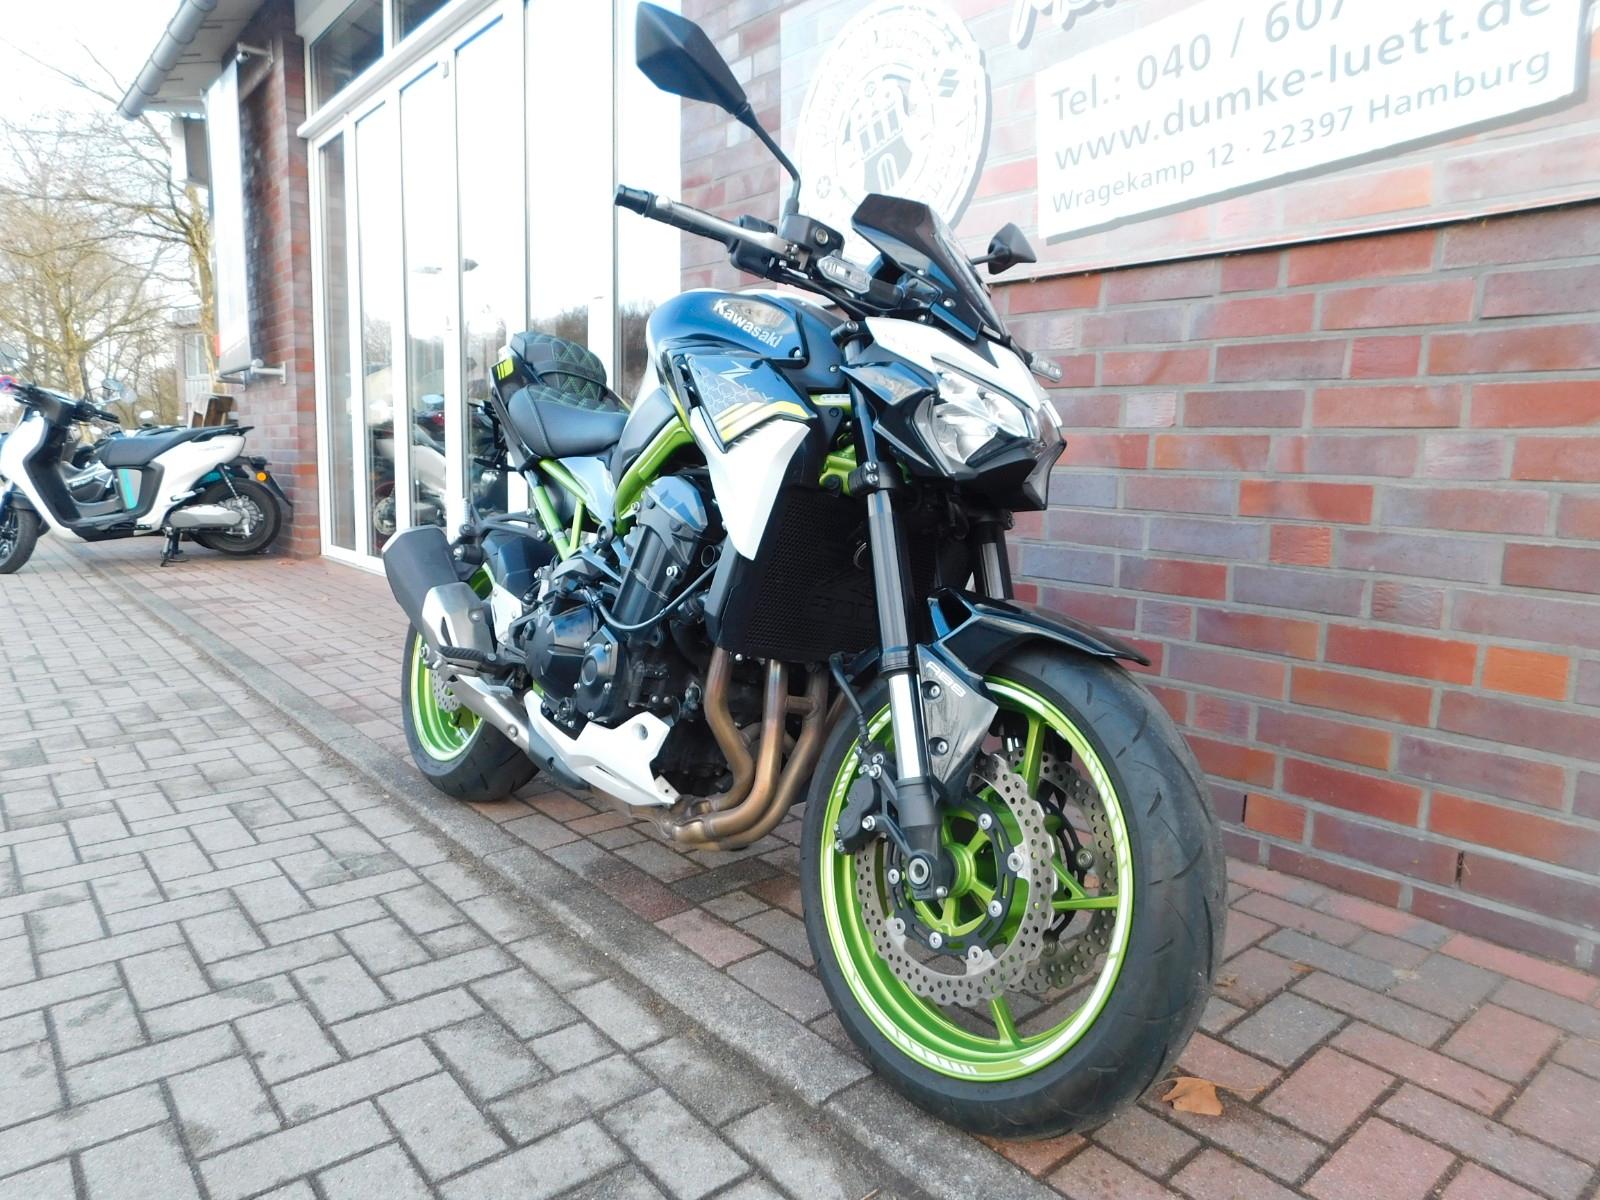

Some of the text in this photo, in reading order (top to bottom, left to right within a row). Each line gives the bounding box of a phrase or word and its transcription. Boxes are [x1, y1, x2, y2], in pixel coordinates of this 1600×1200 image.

[1050, 73, 1121, 120] Tel.:
[1136, 33, 1211, 91] 040
[1054, 0, 1551, 170] www.dumke-luett.de
[1052, 159, 1195, 213] Wragekamp
[1207, 142, 1235, 169] 12
[1261, 105, 1354, 154] 22397
[1369, 50, 1550, 124] Hamburg
[712, 298, 783, 348] Kawasaki
[926, 660, 967, 698] ABS
